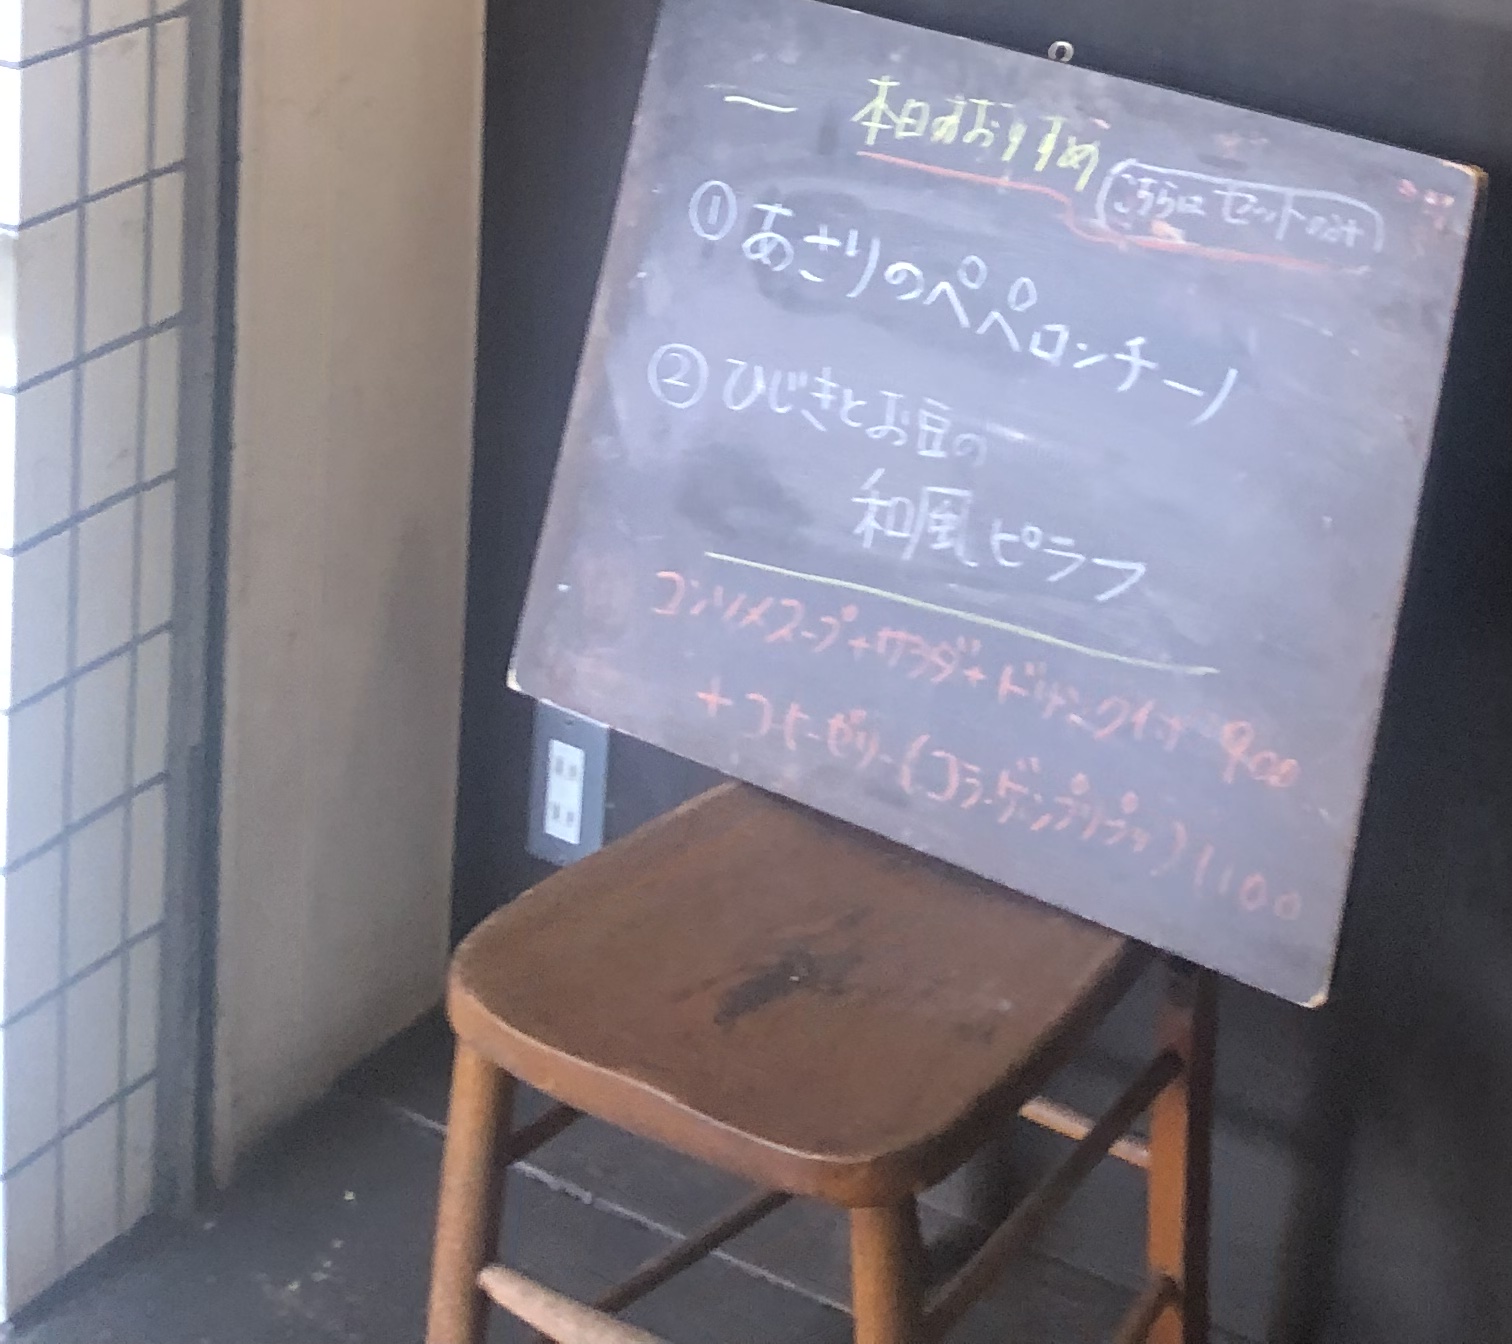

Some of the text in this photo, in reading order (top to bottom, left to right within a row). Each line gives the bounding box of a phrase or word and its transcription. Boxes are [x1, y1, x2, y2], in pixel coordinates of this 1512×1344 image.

[741, 201, 1240, 425] あさりのペペロンチーノ
[722, 356, 988, 467] ひじきとお豆の
[850, 467, 1147, 602] 和風ピラフ
